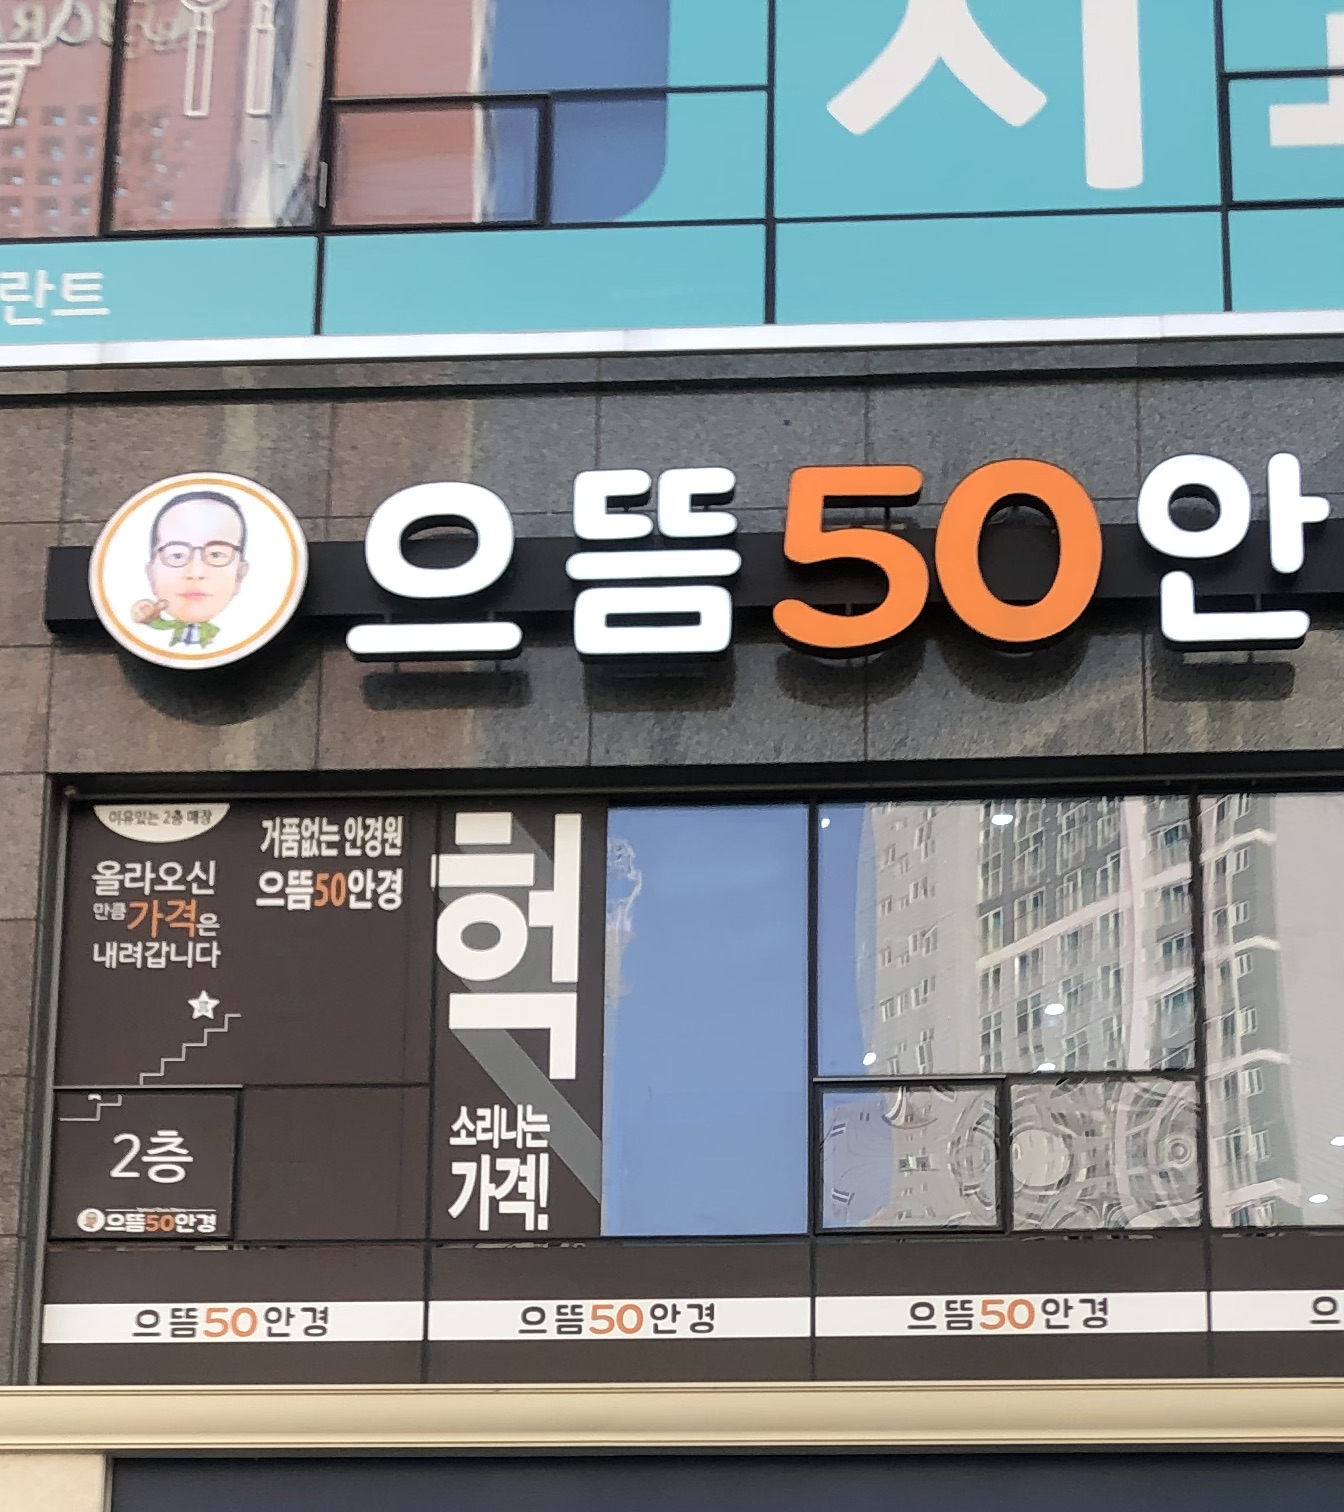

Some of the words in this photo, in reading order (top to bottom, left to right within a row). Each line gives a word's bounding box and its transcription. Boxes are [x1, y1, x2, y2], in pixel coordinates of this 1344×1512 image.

[163, 809, 183, 826] 2층
[187, 809, 212, 825] 매장
[260, 816, 341, 858] 거품없는
[344, 816, 404, 857] 안경원
[92, 860, 216, 896] 올라오신
[256, 868, 404, 911] 으뜸50안경
[93, 902, 127, 921] 만큼
[93, 941, 221, 969] 내려갑니다
[451, 1104, 551, 1150] 소리나는
[109, 1130, 194, 1184] 2층
[449, 1153, 550, 1232] 가격!
[104, 1213, 218, 1233] 으뜸50안경
[132, 1306, 330, 1340] 으뜸50안경
[518, 1301, 716, 1335] 으뜸50안경
[906, 1297, 1109, 1331] 으뜸50안경
